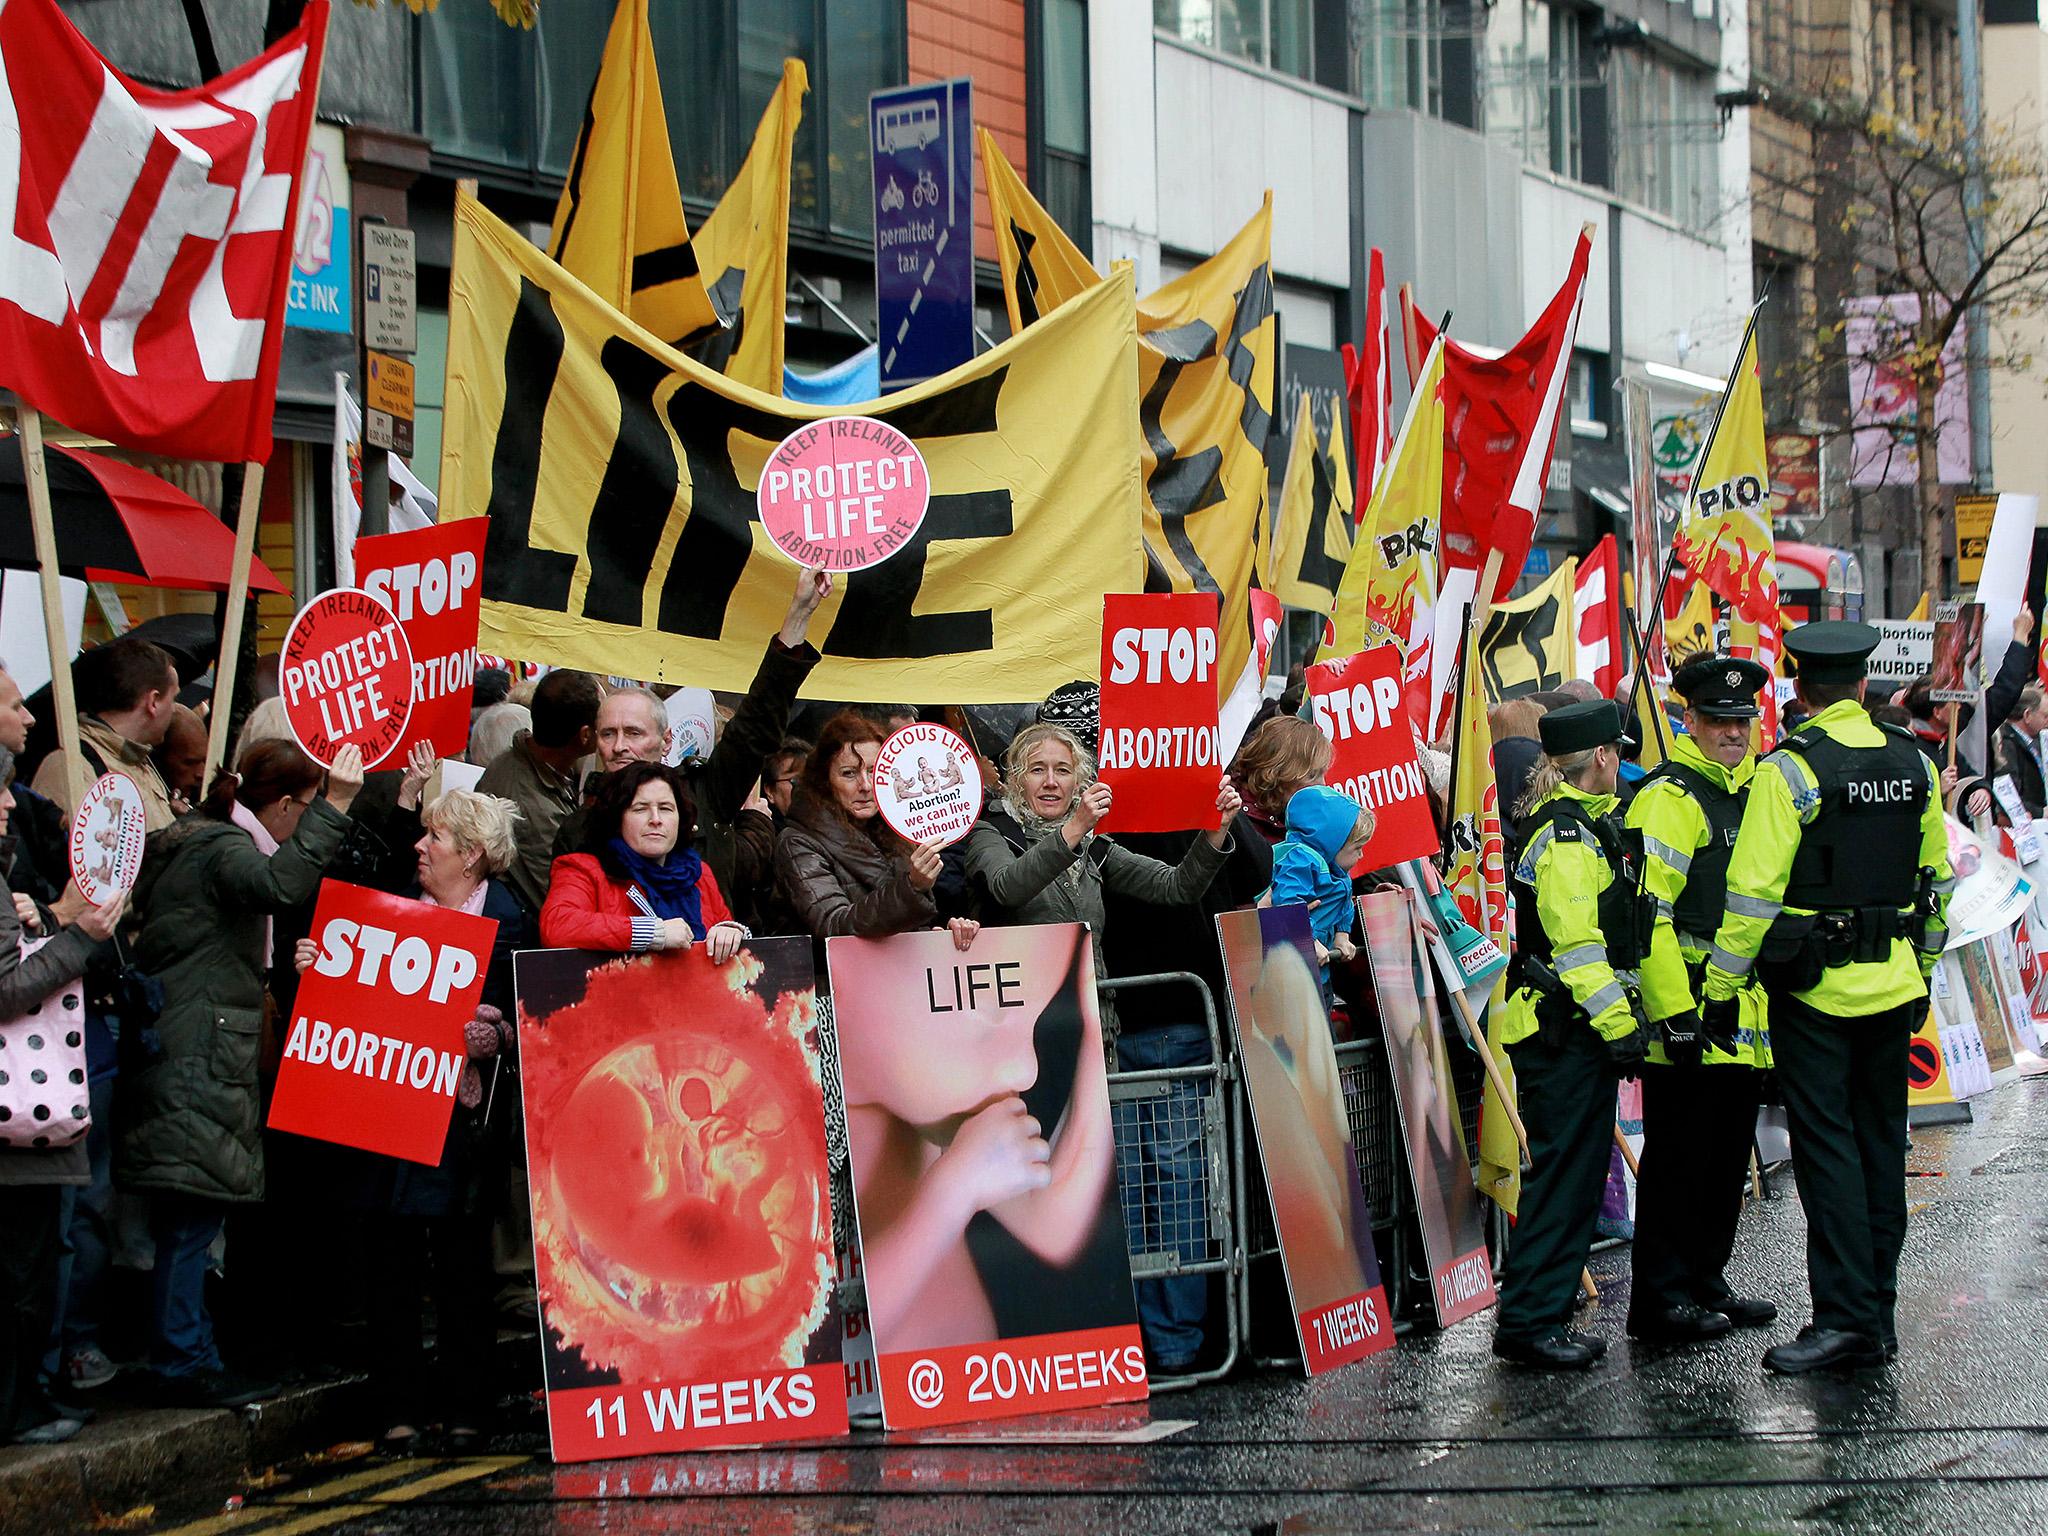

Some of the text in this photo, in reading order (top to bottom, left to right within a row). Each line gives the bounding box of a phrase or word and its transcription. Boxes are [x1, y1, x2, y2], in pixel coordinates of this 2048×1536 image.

[880, 218, 935, 250] permitted
[897, 251, 919, 274] taxi
[311, 281, 340, 314] INK
[481, 274, 1014, 660] LIFE
[776, 420, 907, 467] KEEP IRELAND
[768, 454, 916, 504] PROTECT
[803, 495, 888, 542] LIFE
[364, 551, 476, 622] STOP
[288, 593, 385, 660] KEEP IRELAND
[1896, 643, 1909, 656] is
[285, 622, 399, 707] PROTECT
[412, 646, 476, 703] RTION
[1110, 627, 1216, 684] STOP
[319, 674, 390, 742] LIFE
[1312, 676, 1399, 744] STOP
[876, 727, 972, 786] PRECIOUS LIFE
[904, 800, 971, 827] we can live
[909, 788, 961, 812] Abortion?
[1848, 779, 1913, 804] POLICE
[73, 776, 116, 897] PRECIOUS LIFE
[911, 813, 972, 841] without it
[314, 918, 477, 1004] STOP
[926, 961, 1025, 1013] LIFE
[284, 1016, 463, 1097] ABORTION
[1441, 1255, 1488, 1310] 20 WEEKS
[1312, 1296, 1379, 1355] 7 WEEKS
[586, 1373, 816, 1439] 11 WEEKS
[907, 1358, 944, 1408] @
